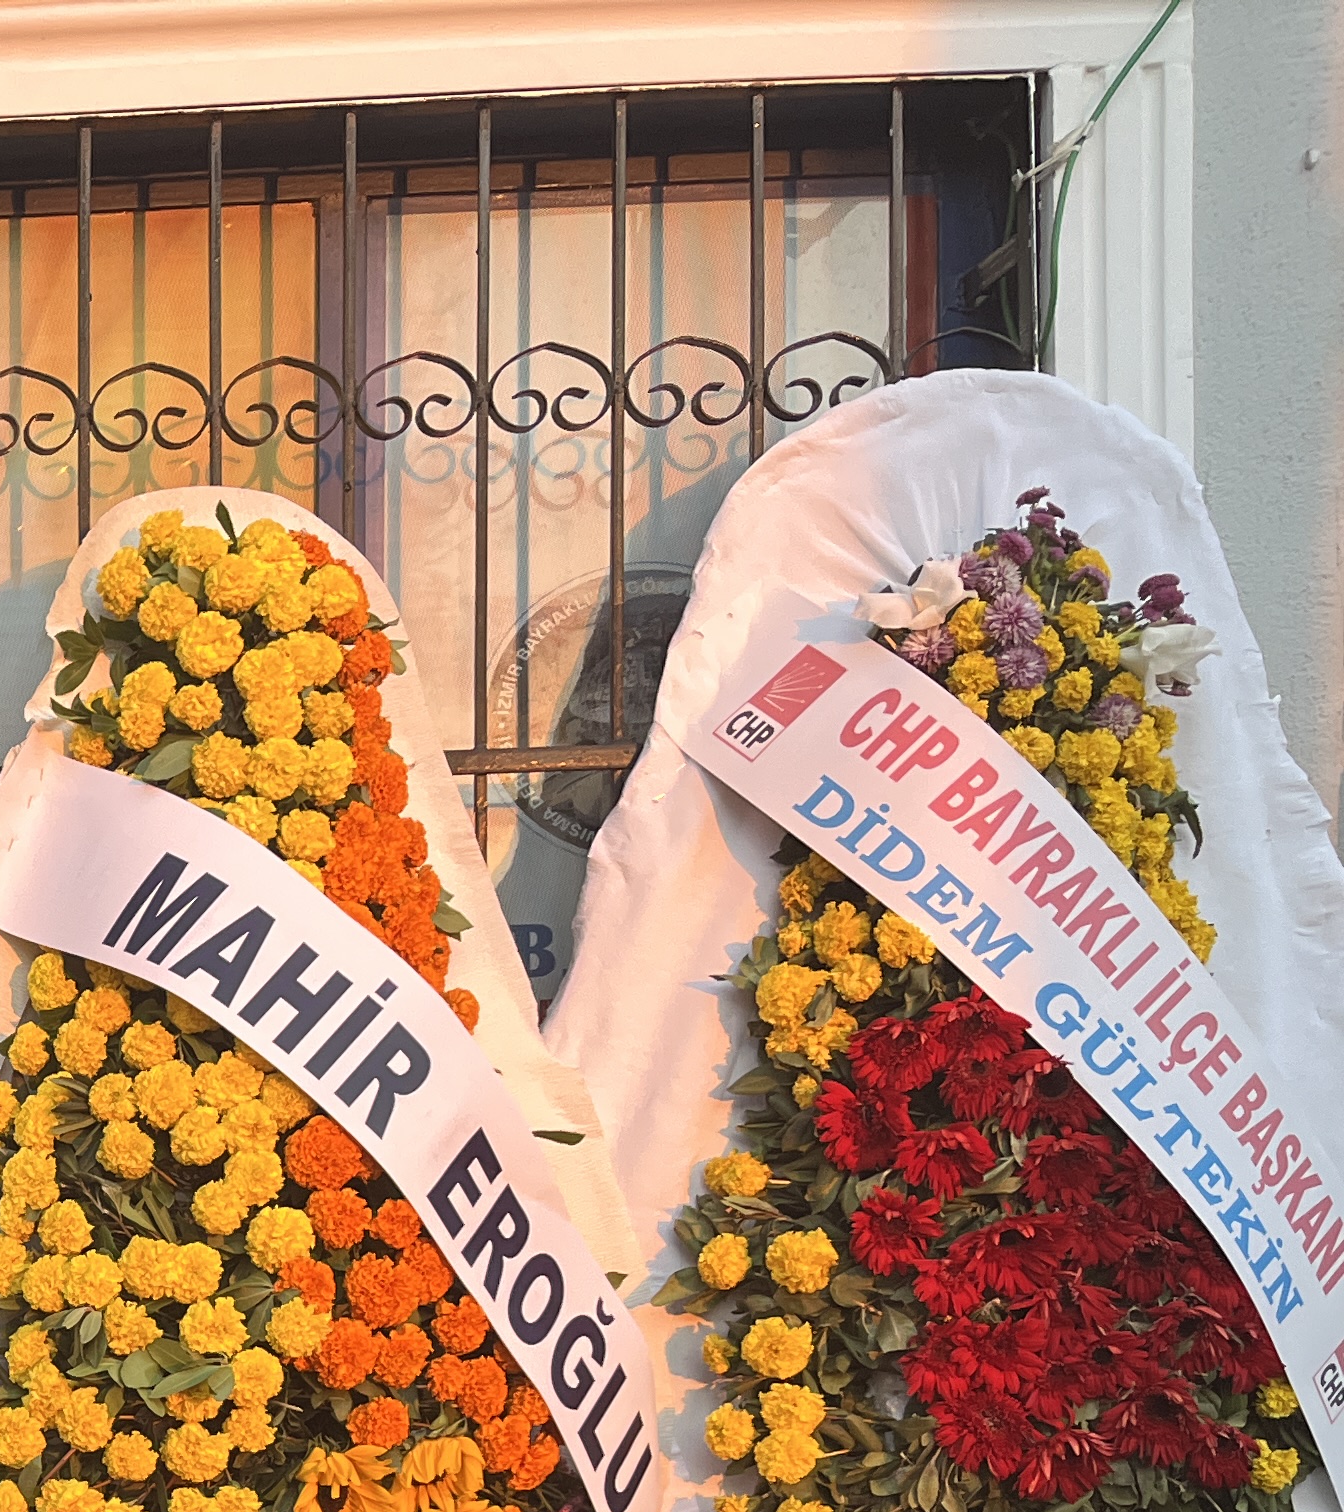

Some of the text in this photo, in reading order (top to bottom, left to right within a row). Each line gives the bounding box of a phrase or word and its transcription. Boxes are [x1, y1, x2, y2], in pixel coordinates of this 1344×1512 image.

[725, 709, 775, 749] CHP
[840, 688, 960, 783] CHP
[927, 758, 1160, 992] BAYRAKLI
[1133, 958, 1242, 1096] İLÇE
[102, 851, 431, 1140] MAHİR
[792, 774, 1304, 1324] DİDEM GÜLTEKİN
